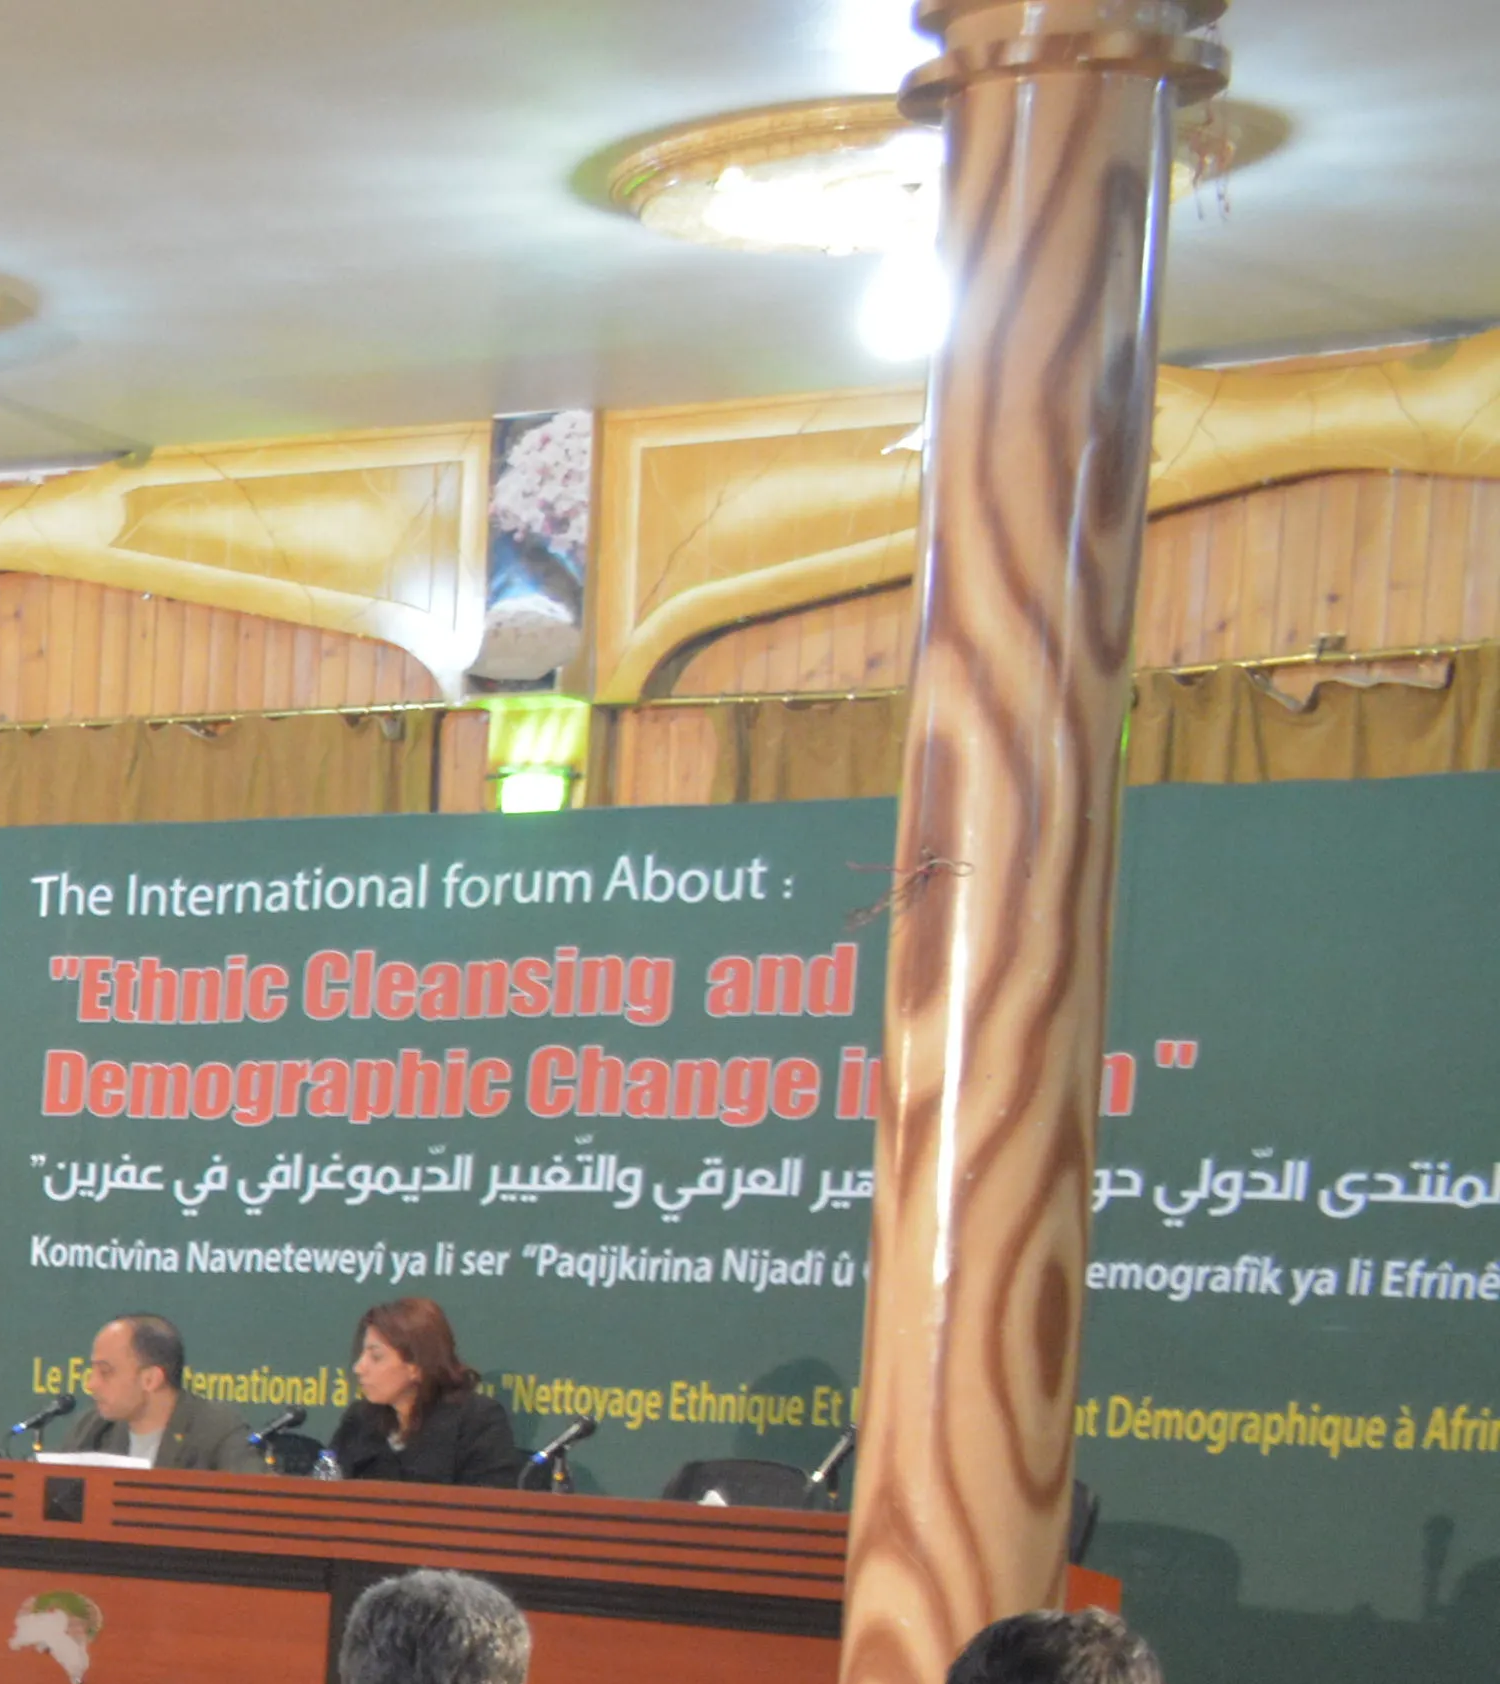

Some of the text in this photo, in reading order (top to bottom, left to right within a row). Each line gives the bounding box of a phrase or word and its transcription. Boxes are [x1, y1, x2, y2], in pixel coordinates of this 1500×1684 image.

[31, 873, 114, 919] The
[125, 862, 428, 915] International
[444, 861, 593, 908] forum
[603, 853, 769, 902] About
[49, 942, 858, 1027] "Ethnic Cleansing and
[41, 1046, 512, 1127] Demographic
[524, 1044, 821, 1127] Change
[174, 1152, 228, 1217] في
[651, 1155, 802, 1224] العرقي
[1091, 1165, 1144, 1214] حو
[1316, 1158, 1500, 1219] لمنتدى
[30, 1234, 180, 1275] Komcivîna
[186, 1236, 384, 1285] Navneteweyî
[389, 1248, 427, 1284] ya
[434, 1241, 455, 1278] li
[459, 1248, 511, 1278] ser
[721, 1246, 825, 1294] Nijadî
[831, 1250, 857, 1287] û
[1085, 1253, 1283, 1303] emografîk
[1288, 1266, 1338, 1307] ya
[1345, 1255, 1374, 1298] li
[31, 1355, 63, 1396] Le
[181, 1364, 328, 1407] ternational
[334, 1371, 350, 1408] à
[667, 1377, 805, 1437] Ethnique
[810, 1385, 845, 1430] Et
[1104, 1394, 1388, 1460] Démographique
[1392, 1404, 1415, 1452] à
